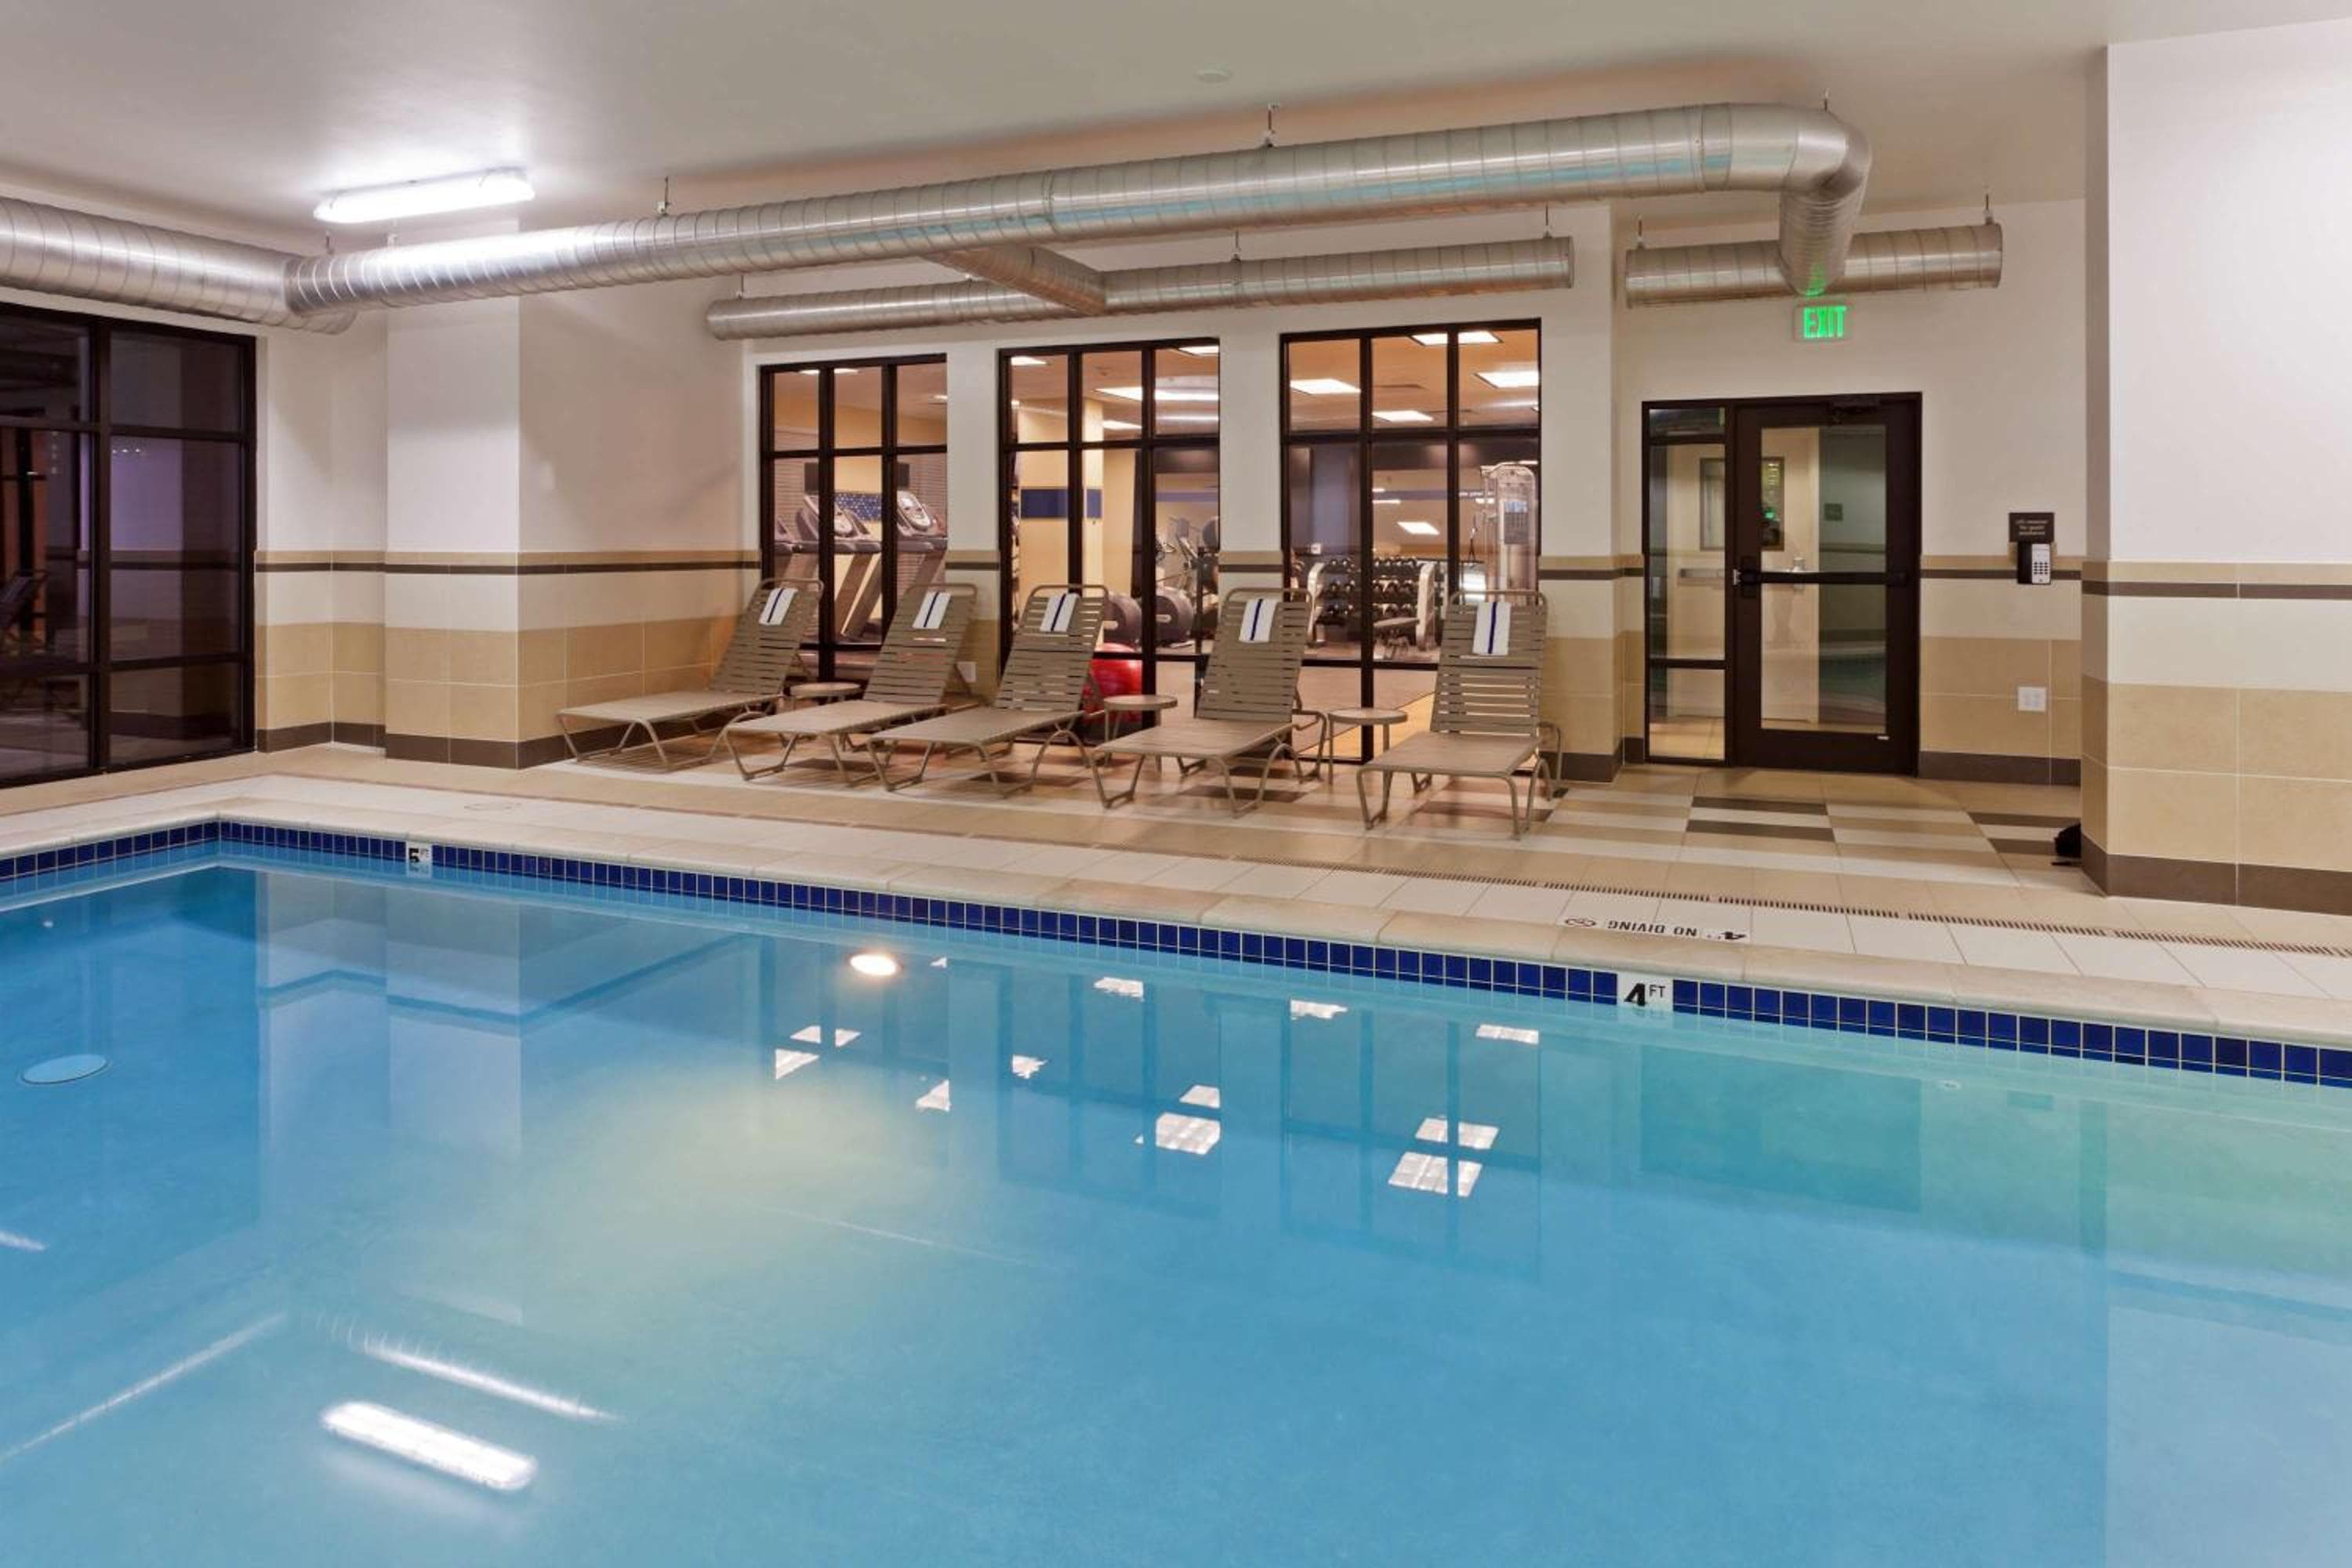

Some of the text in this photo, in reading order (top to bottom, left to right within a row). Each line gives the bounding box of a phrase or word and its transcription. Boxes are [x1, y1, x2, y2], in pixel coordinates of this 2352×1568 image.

[1804, 306, 1846, 339] EXIT
[408, 848, 420, 862] 5
[1608, 920, 1665, 934] DIVING
[1674, 927, 1697, 937] NO
[1624, 982, 1666, 1007] 4 FT
